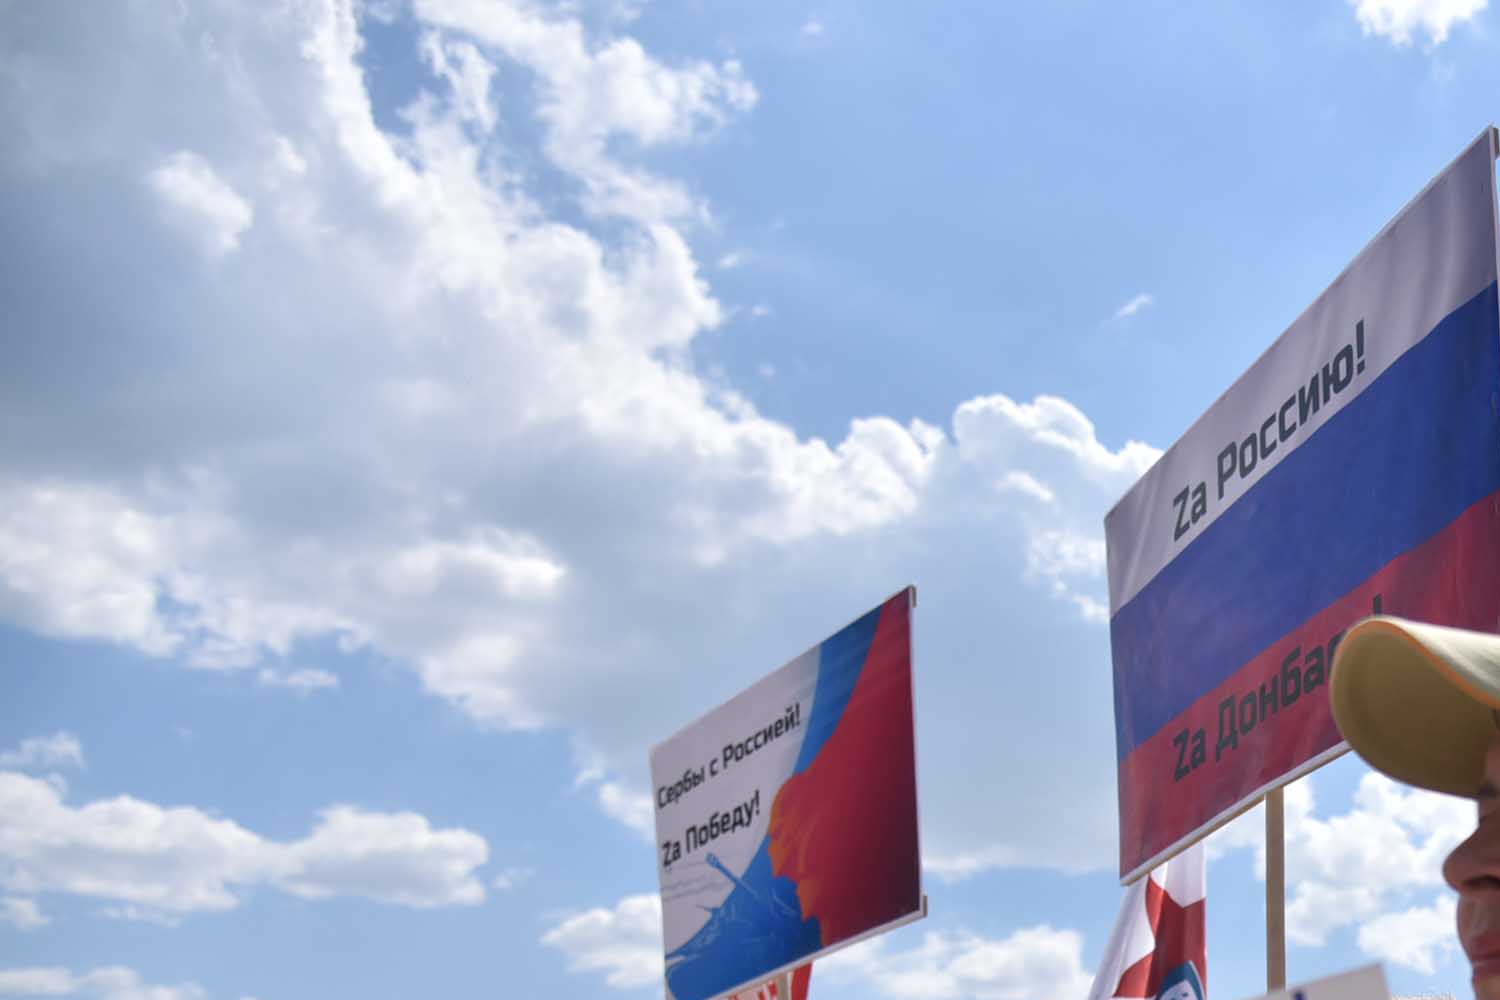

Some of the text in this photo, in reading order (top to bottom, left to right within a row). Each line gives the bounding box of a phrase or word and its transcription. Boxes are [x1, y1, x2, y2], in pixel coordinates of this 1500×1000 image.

[1172, 318, 1367, 541] Za Россию!
[657, 703, 801, 808] Сербы с Россией!
[1172, 728, 1206, 781] Za
[661, 790, 760, 867] Za Победу!
